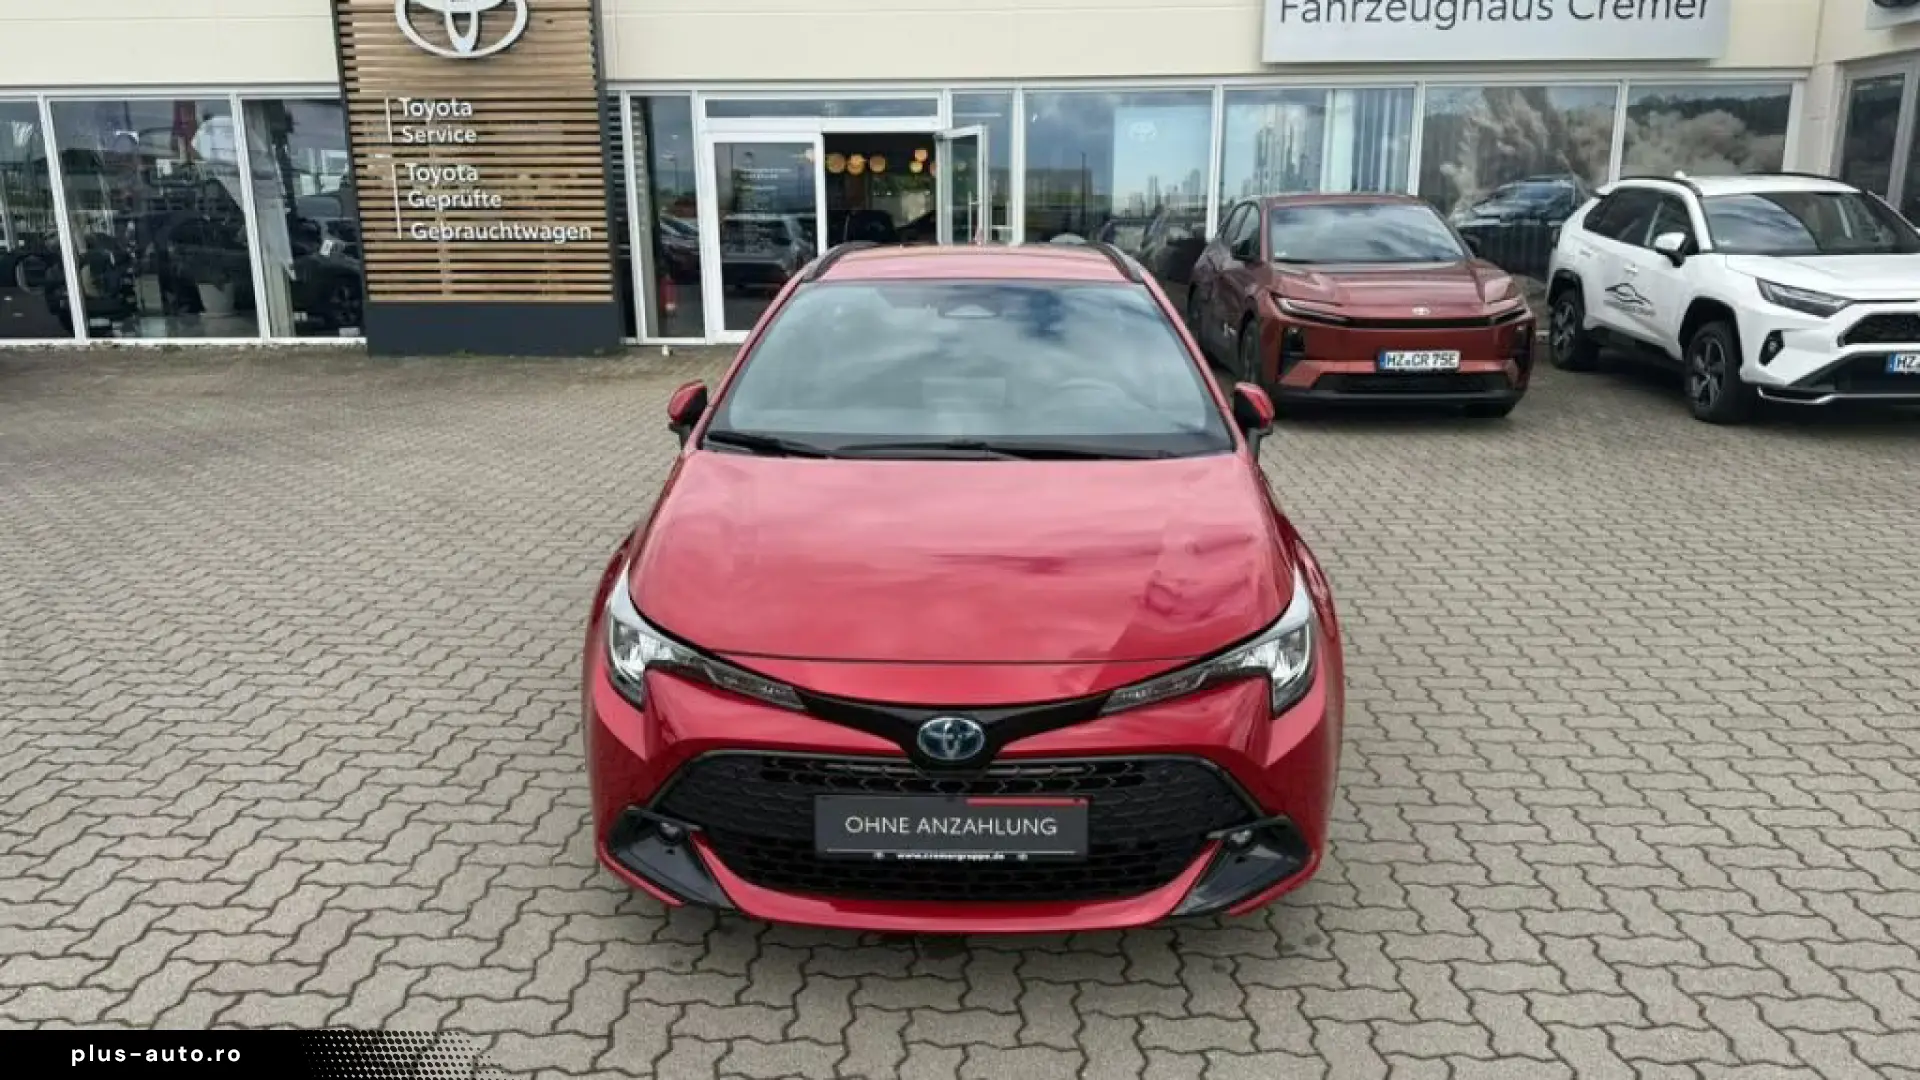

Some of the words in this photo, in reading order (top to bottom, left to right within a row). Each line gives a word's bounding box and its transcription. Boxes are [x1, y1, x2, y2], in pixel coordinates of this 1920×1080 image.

[1280, 0, 1553, 30] Fahrzeughaus
[1568, 0, 1708, 20] Cremer
[399, 97, 473, 121] Toyota
[402, 125, 477, 144] Service
[405, 162, 479, 186] Toyota
[408, 188, 503, 213] Geprüfte
[411, 220, 593, 245] Gebrauchtwagen
[1386, 353, 1404, 367] HZ
[1411, 353, 1430, 367] CR
[845, 816, 910, 834] OHNE
[916, 816, 1058, 836] ANZAHLUNG
